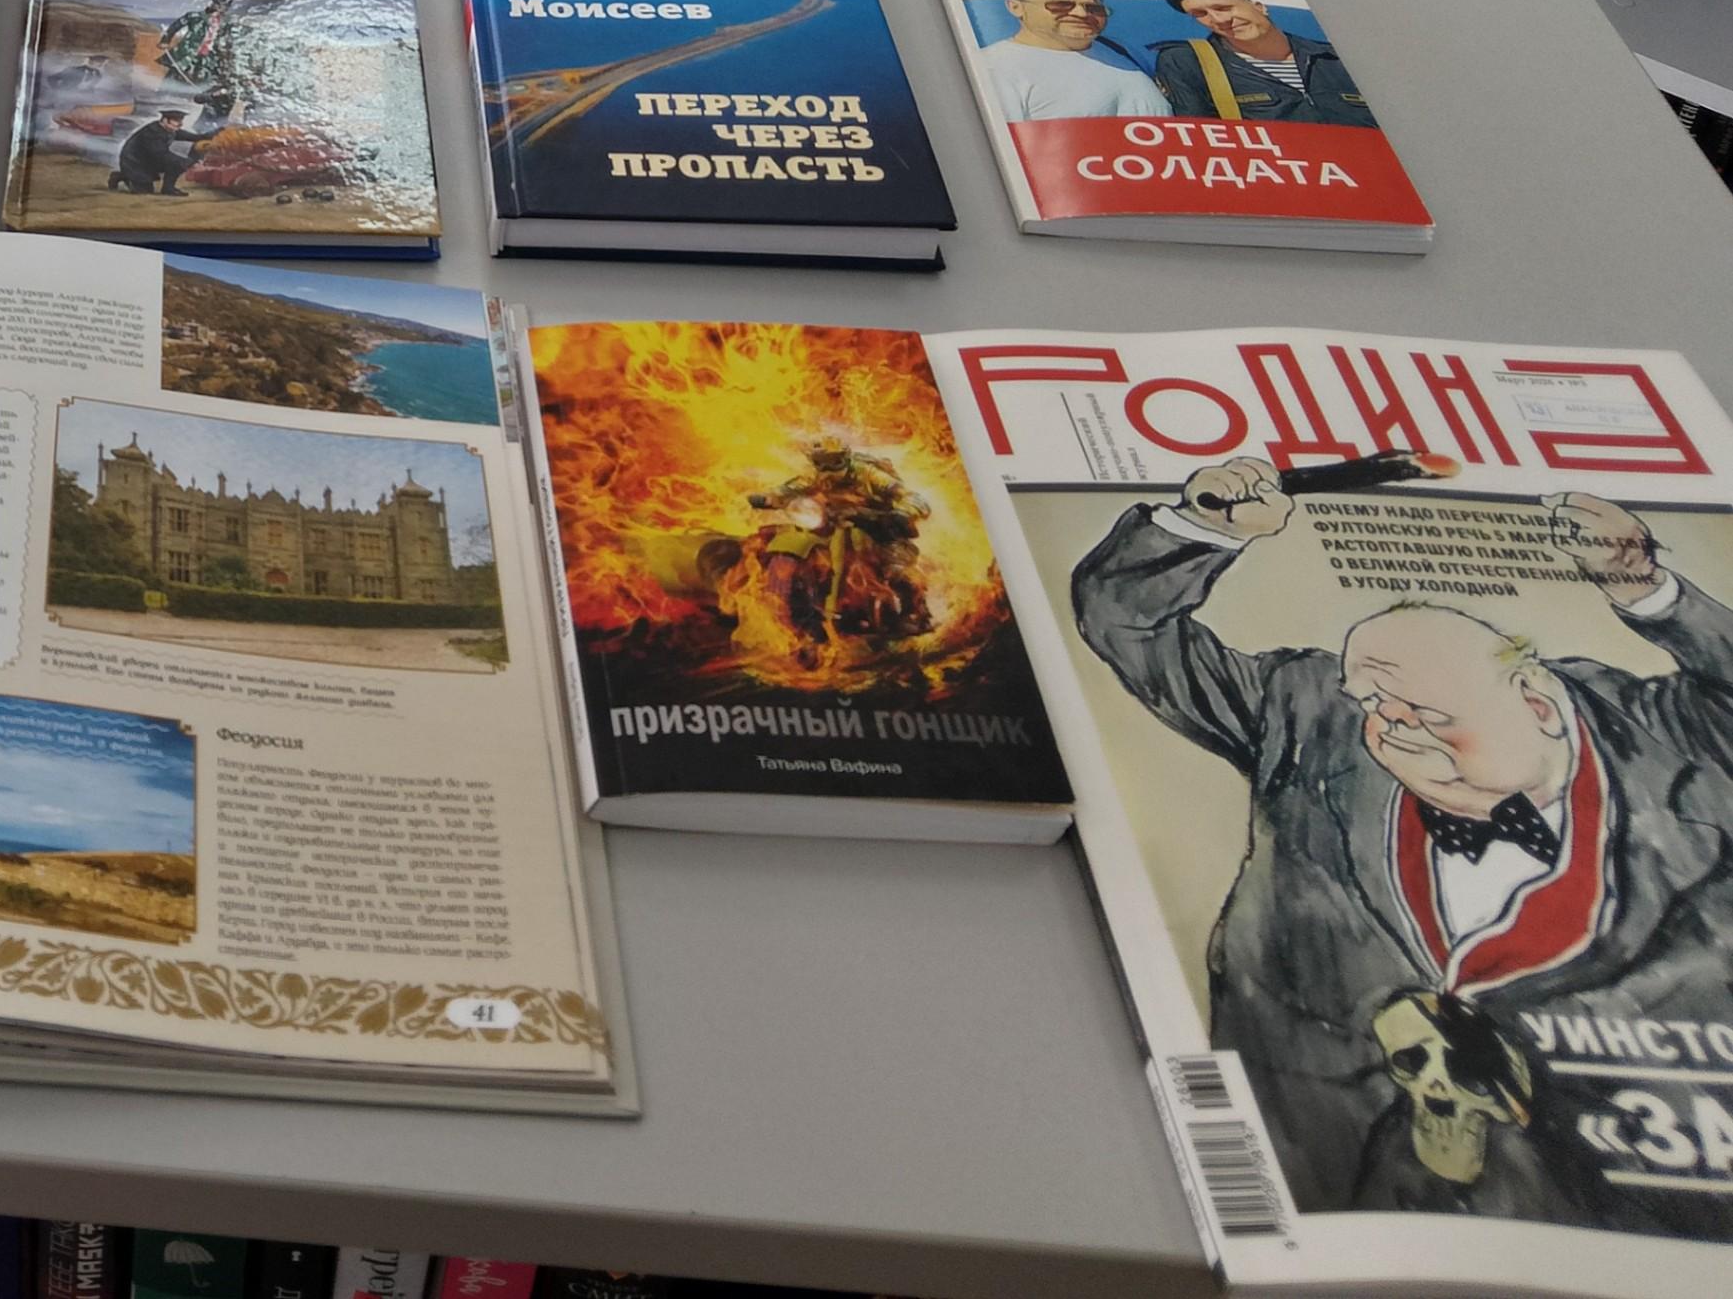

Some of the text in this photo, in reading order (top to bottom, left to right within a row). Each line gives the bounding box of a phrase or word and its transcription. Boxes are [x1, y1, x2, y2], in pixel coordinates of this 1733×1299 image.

[634, 92, 868, 124] ПЕРЕХОД
[712, 124, 875, 150] ЧЕРЕЗ
[1122, 121, 1282, 157] ОТЕЦ
[607, 152, 886, 182] ПРОПАСТЬ
[1075, 154, 1360, 189] СОЛДАТА
[1305, 502, 1380, 518] ПОЧЕМУ
[1383, 505, 1435, 521] НАДО
[1313, 521, 1442, 539] ФУЛТОНСКУЮ
[1446, 527, 1492, 542] РЕЧЬ
[1495, 530, 1506, 542] 5
[1509, 530, 1572, 546] МАРТА
[1321, 538, 1555, 563] РАСТОПТАВШУЮ ПАМЯТЬ
[1330, 556, 1344, 570] О
[1347, 555, 1435, 574] ВЕЛИКОЙ
[1439, 562, 1589, 584] ОТЕЧЕСТВЕННОЙ
[1338, 575, 1520, 598] В УГОДУ ХОЛОДНОЙ
[609, 697, 865, 744] призрачный
[873, 708, 1035, 749] гонщик
[216, 728, 305, 751] Феодосия
[756, 754, 904, 776] Татьяна Вафина
[471, 1004, 496, 1022] 41
